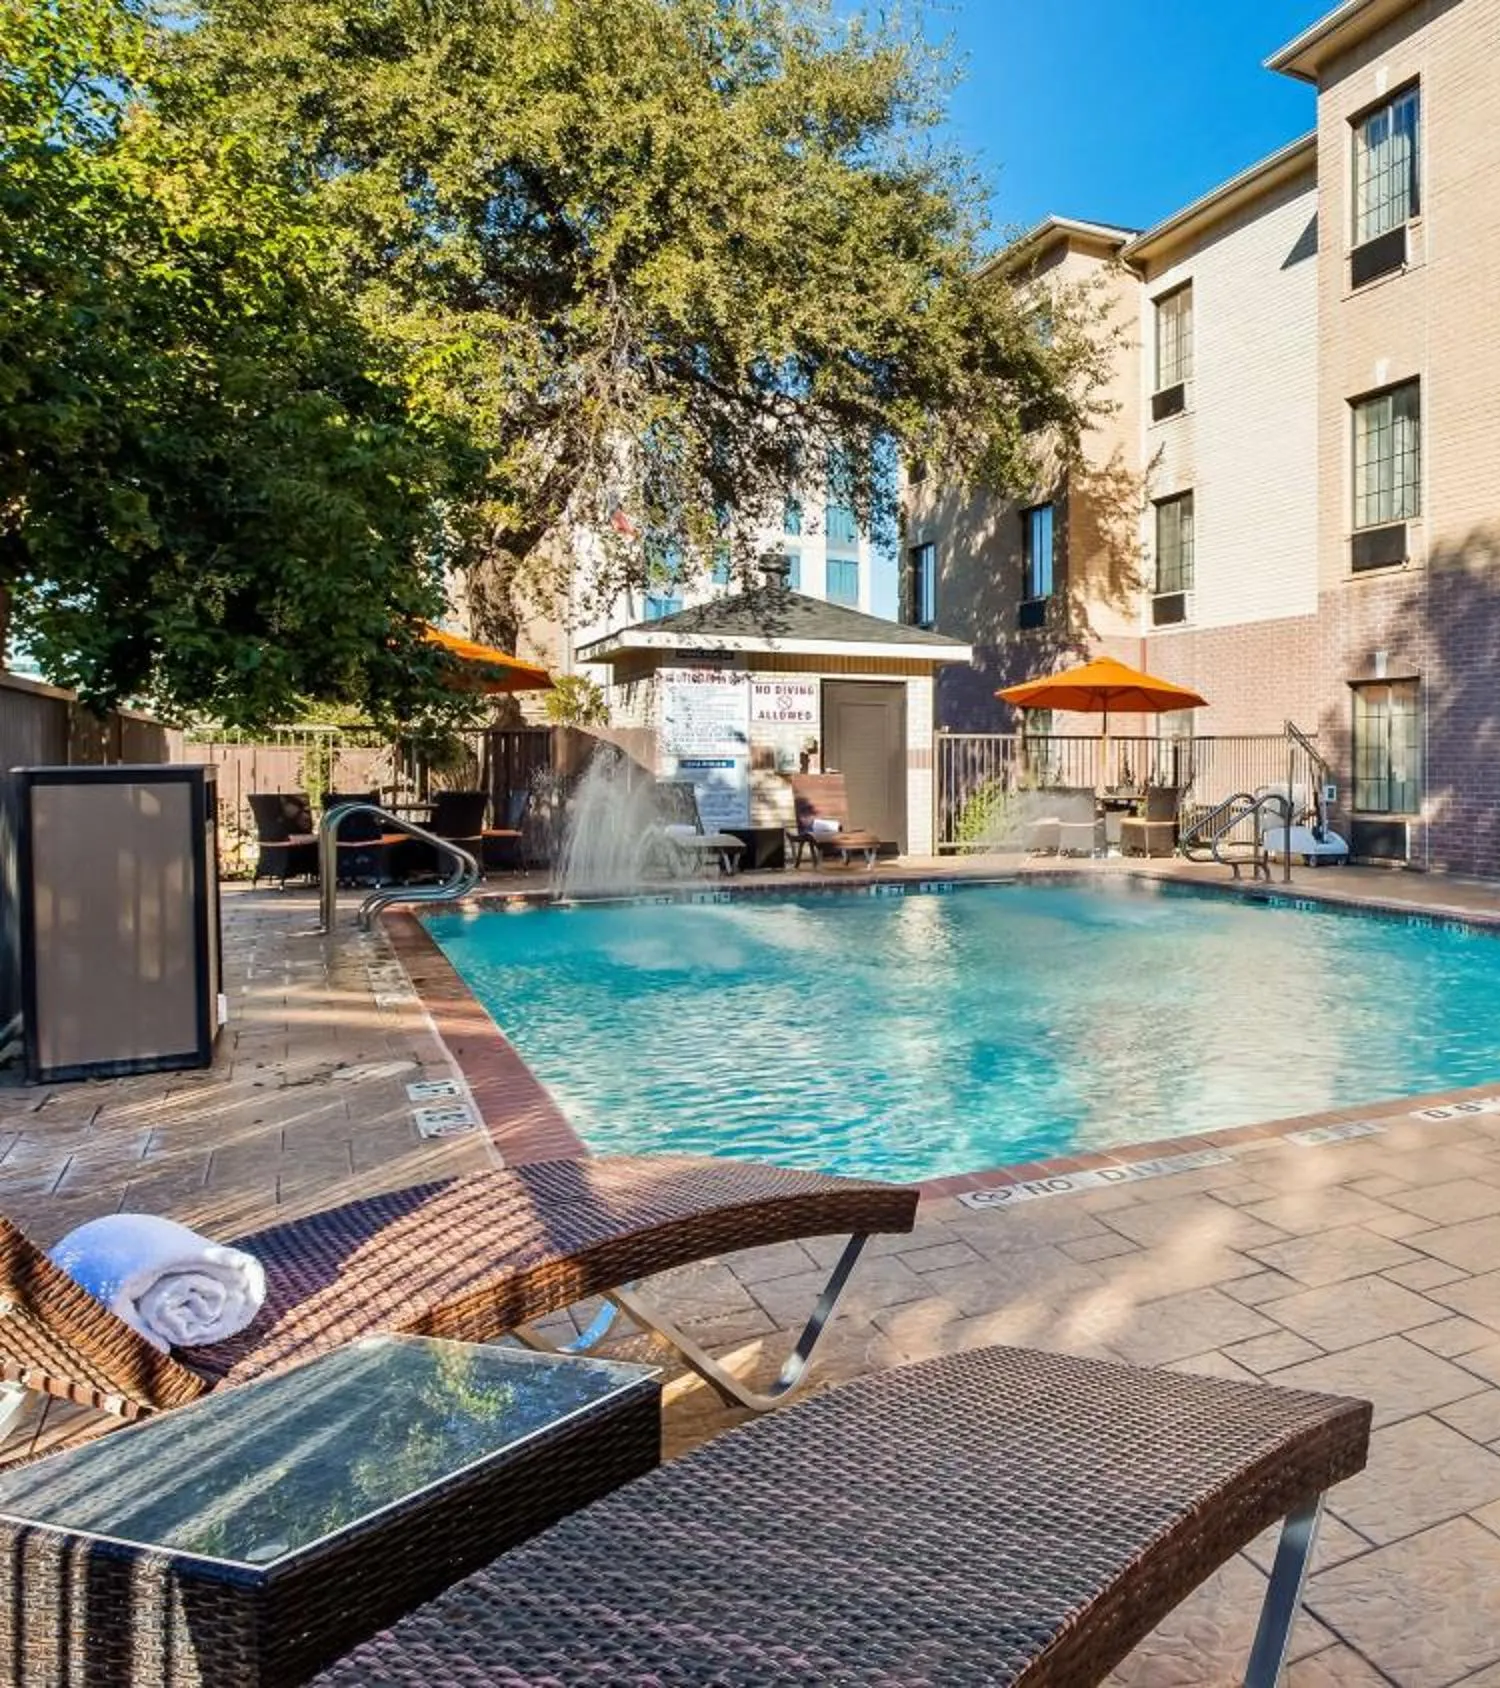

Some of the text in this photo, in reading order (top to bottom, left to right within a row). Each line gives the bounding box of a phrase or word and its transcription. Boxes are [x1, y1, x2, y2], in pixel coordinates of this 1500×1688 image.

[755, 685, 815, 695] NO DIVING
[758, 710, 813, 721] ALLOWED
[1026, 1178, 1073, 1196] NO
